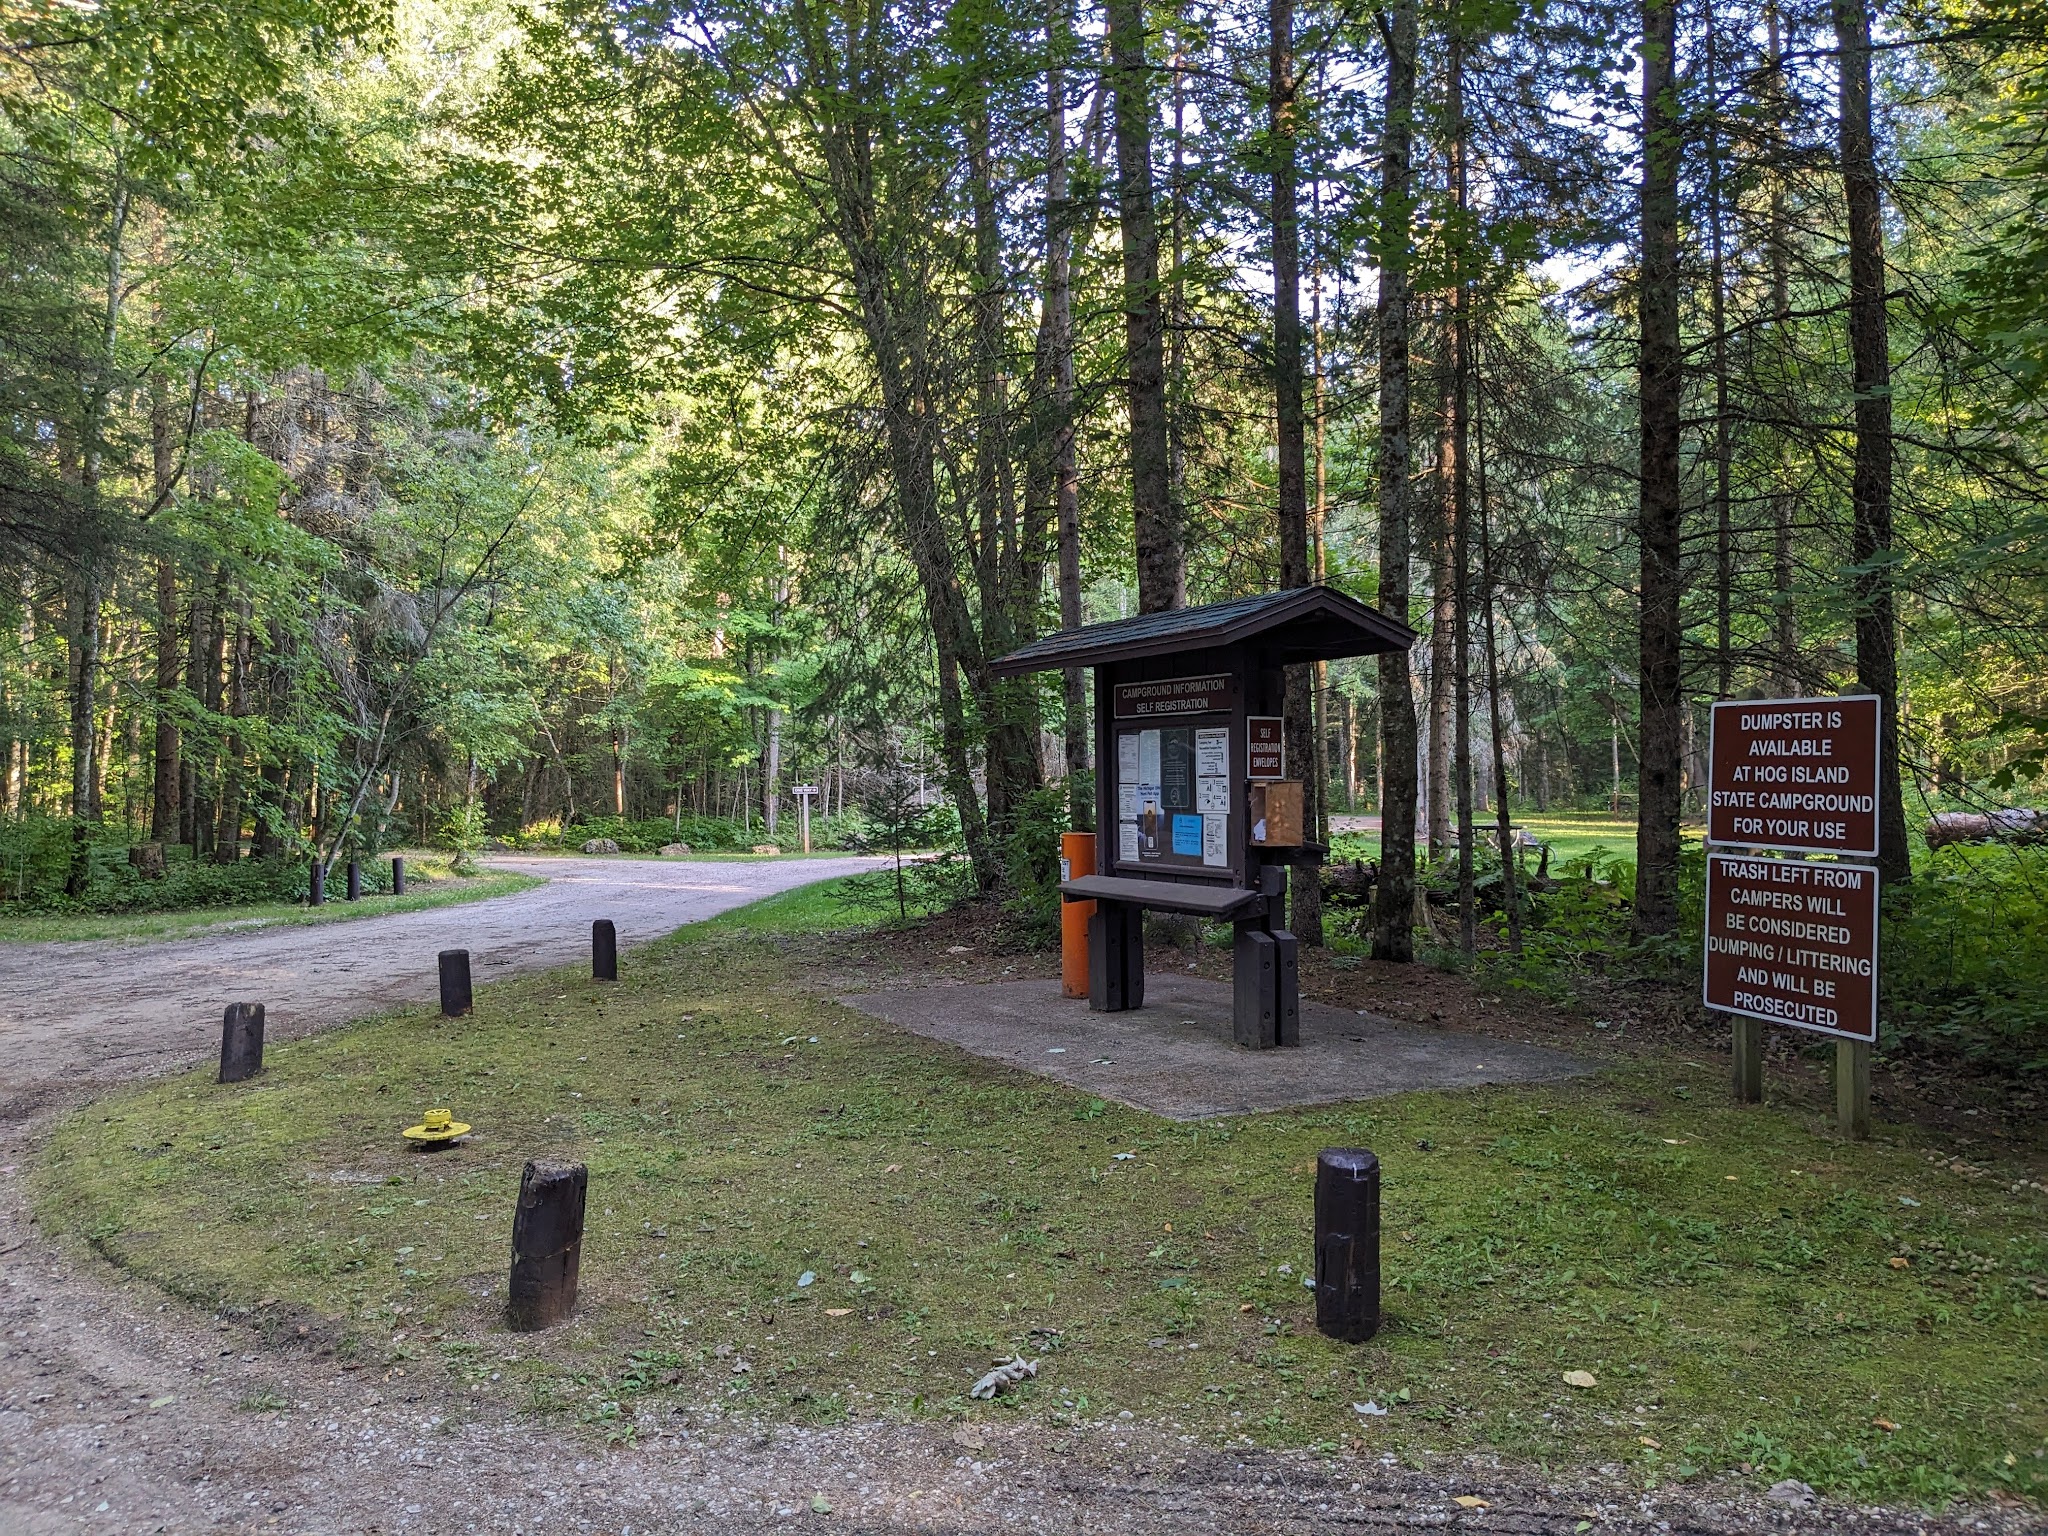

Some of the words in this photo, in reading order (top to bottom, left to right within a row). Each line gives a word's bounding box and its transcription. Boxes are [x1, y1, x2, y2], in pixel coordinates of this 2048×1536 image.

[1122, 684, 1172, 699] CAMPGROUND
[1173, 679, 1225, 694] INFORMATION
[1136, 702, 1154, 713] SELF
[1155, 698, 1208, 712] REGISTRATION
[1741, 712, 1823, 731] DUMPSTER
[1827, 711, 1842, 729] IS
[1260, 727, 1271, 738] SELF
[1251, 742, 1281, 753] REGISTRATION
[1749, 739, 1832, 756] AVAILABLE
[1253, 757, 1279, 768] ENVELOPES
[1733, 766, 1751, 782] AT
[1755, 766, 1788, 783] HOG
[1791, 766, 1850, 784] ISLAND
[1713, 791, 1755, 807] STATE
[1759, 792, 1873, 813] CAMPGROUND
[1733, 817, 1763, 835] FOR
[1766, 819, 1809, 838] YOUR
[1813, 821, 1846, 840] USE
[1720, 861, 1768, 881] TRASH
[1772, 865, 1810, 885] LEFT
[1814, 869, 1861, 890] FROM
[1730, 888, 1803, 912] CAMPERS
[1807, 896, 1846, 916] WILL
[1726, 912, 1745, 931] BE
[1749, 915, 1851, 945] CONSIDERED
[1709, 936, 1775, 961] DUMPING
[1778, 946, 1783, 962] /
[1787, 947, 1871, 976] LITTERING
[1737, 966, 1768, 986] AND
[1772, 971, 1809, 994] WILL
[1813, 979, 1836, 999] BE
[1733, 991, 1838, 1027] PROSECUTED
